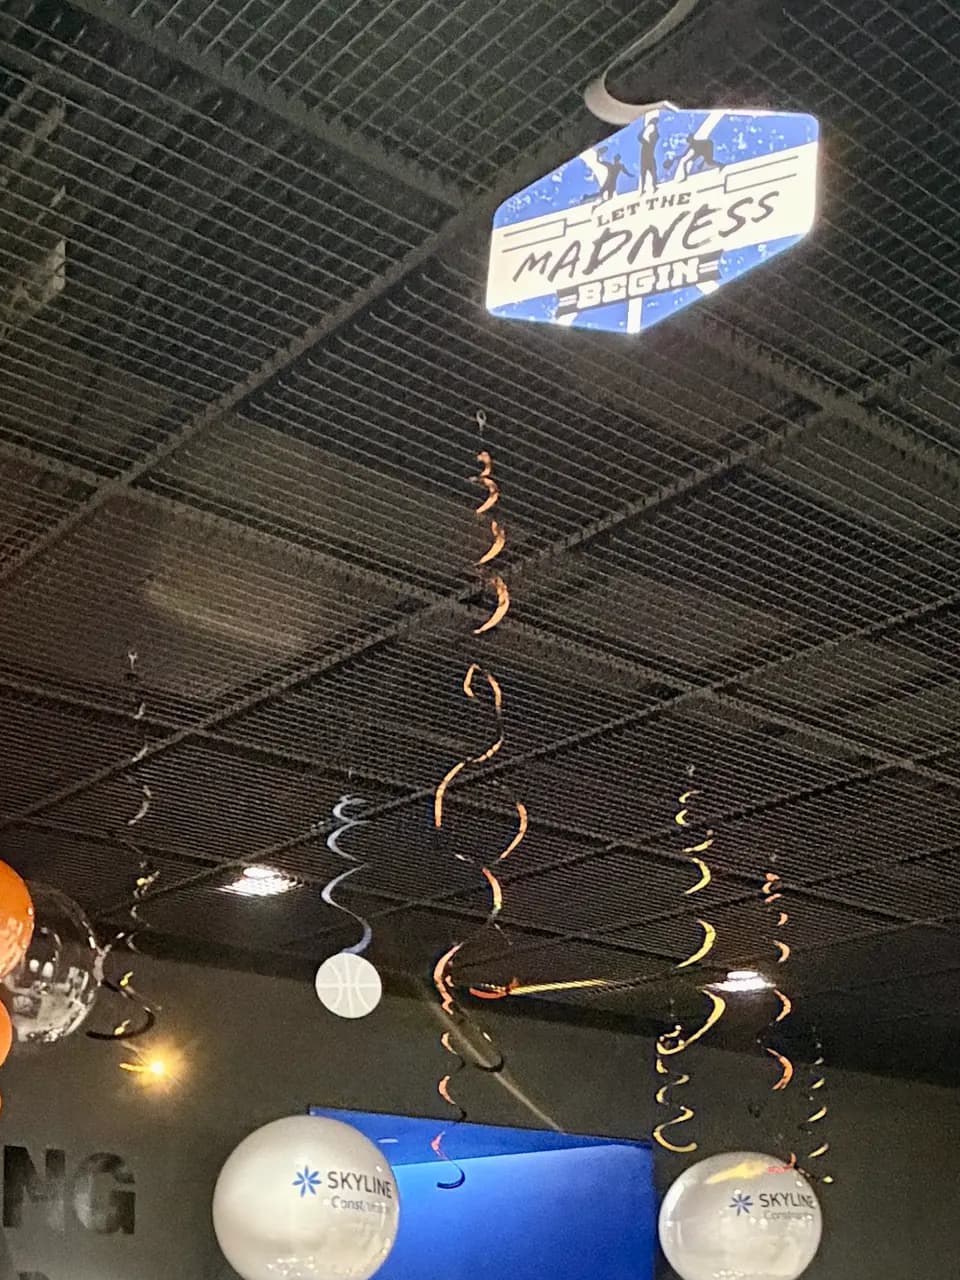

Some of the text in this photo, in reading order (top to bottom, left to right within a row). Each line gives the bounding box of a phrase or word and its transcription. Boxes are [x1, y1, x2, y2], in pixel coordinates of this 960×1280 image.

[597, 192, 692, 227] LET THE
[513, 190, 781, 283] MADNESS
[577, 259, 700, 309] BEGIN
[327, 1171, 392, 1199] SKYLINE
[759, 1192, 816, 1209] SKYLINE
